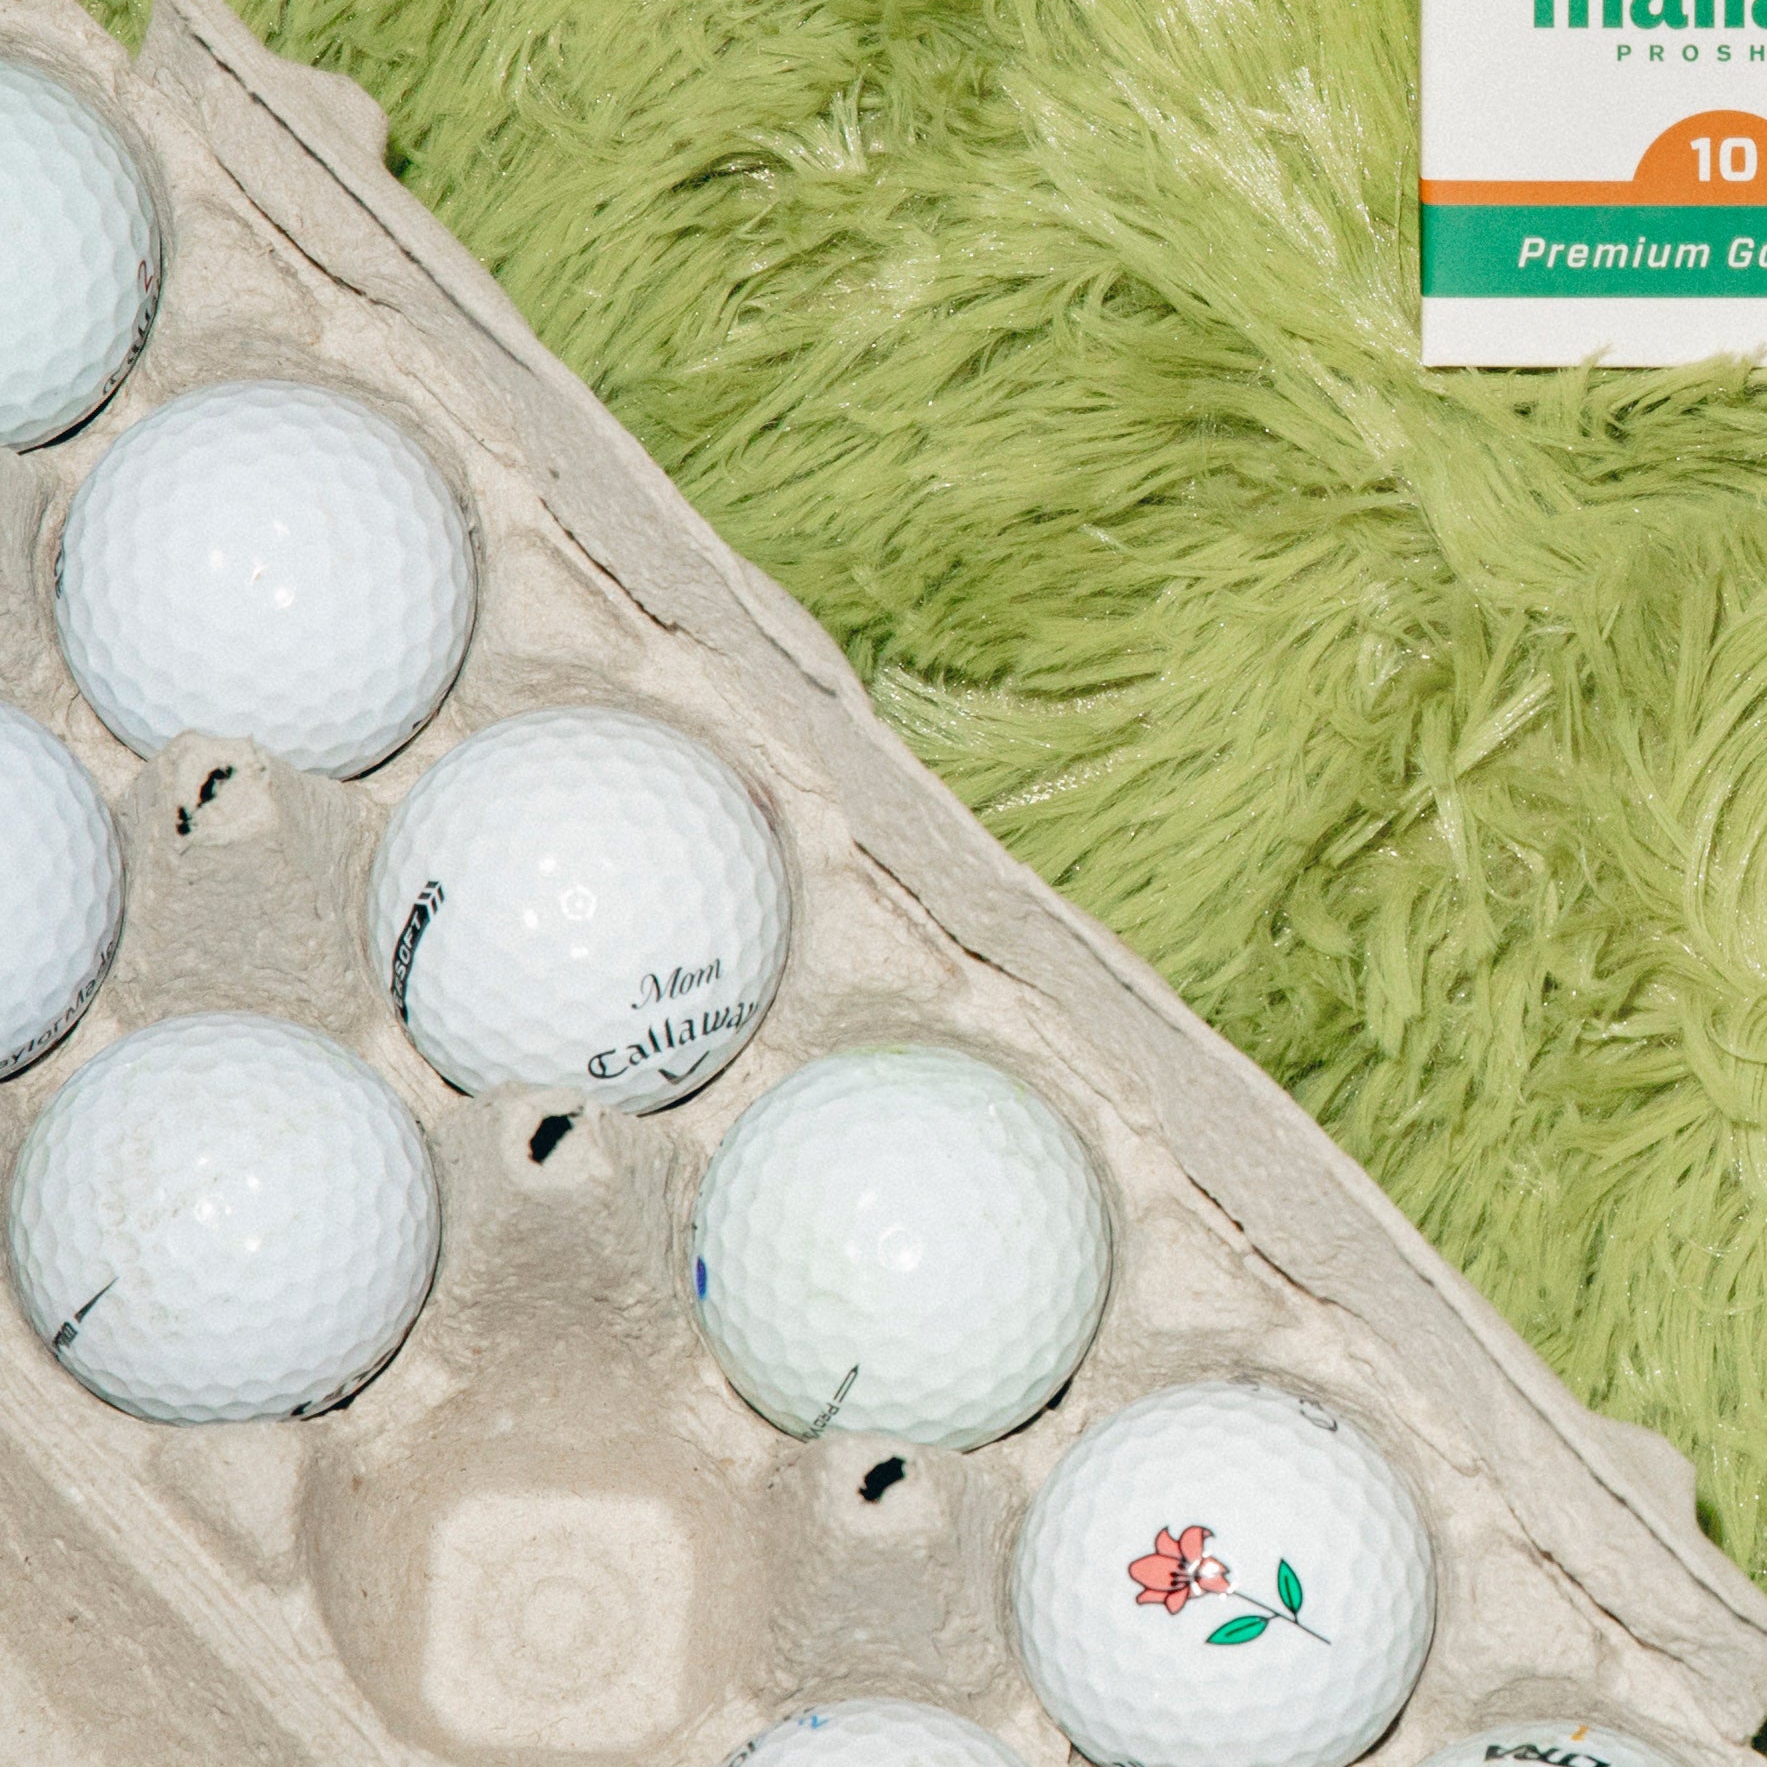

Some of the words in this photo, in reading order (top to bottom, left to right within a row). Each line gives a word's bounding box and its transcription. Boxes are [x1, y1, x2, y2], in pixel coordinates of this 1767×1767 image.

[1689, 136, 1758, 182] 10
[1518, 235, 1711, 269] Premium
[631, 958, 722, 1009] Mom
[588, 1002, 759, 1079] Callaway
